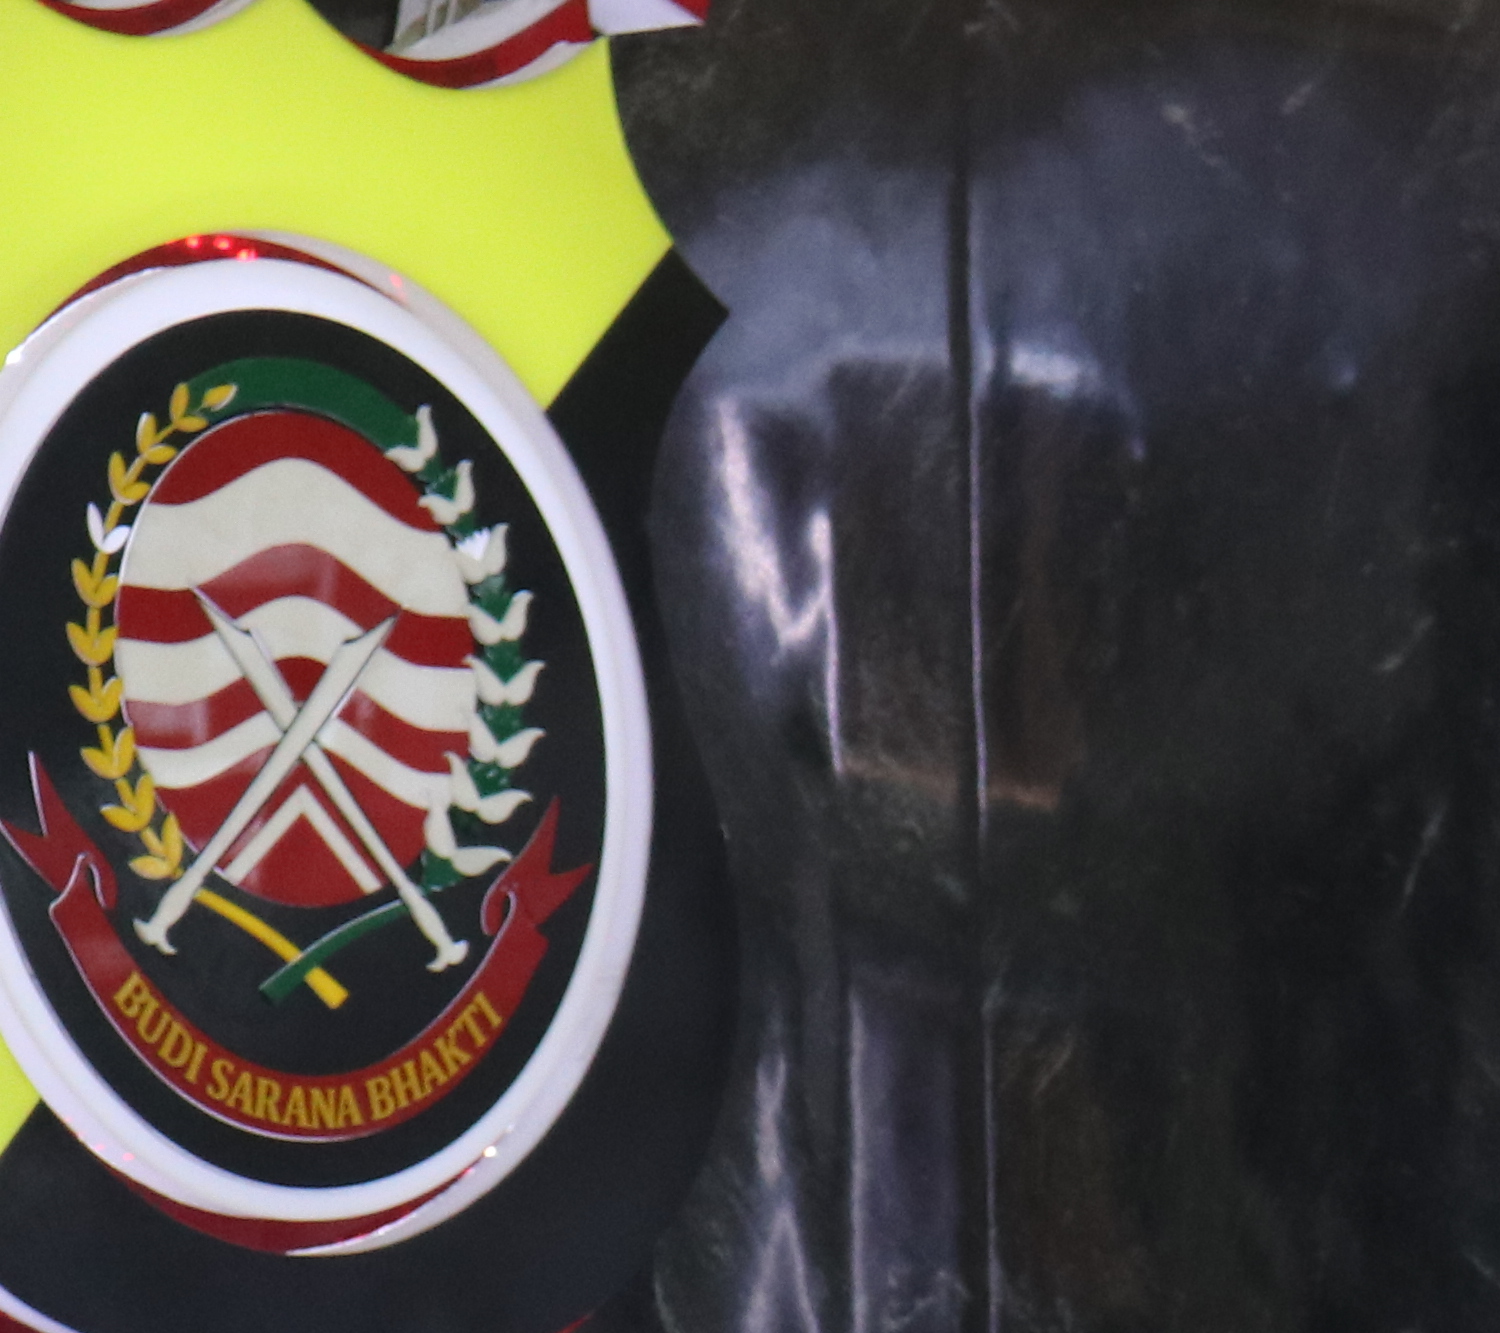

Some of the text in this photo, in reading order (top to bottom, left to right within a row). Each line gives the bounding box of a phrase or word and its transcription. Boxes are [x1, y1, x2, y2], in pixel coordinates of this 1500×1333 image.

[113, 970, 502, 1130] BUDI SARANA BHAKTI
